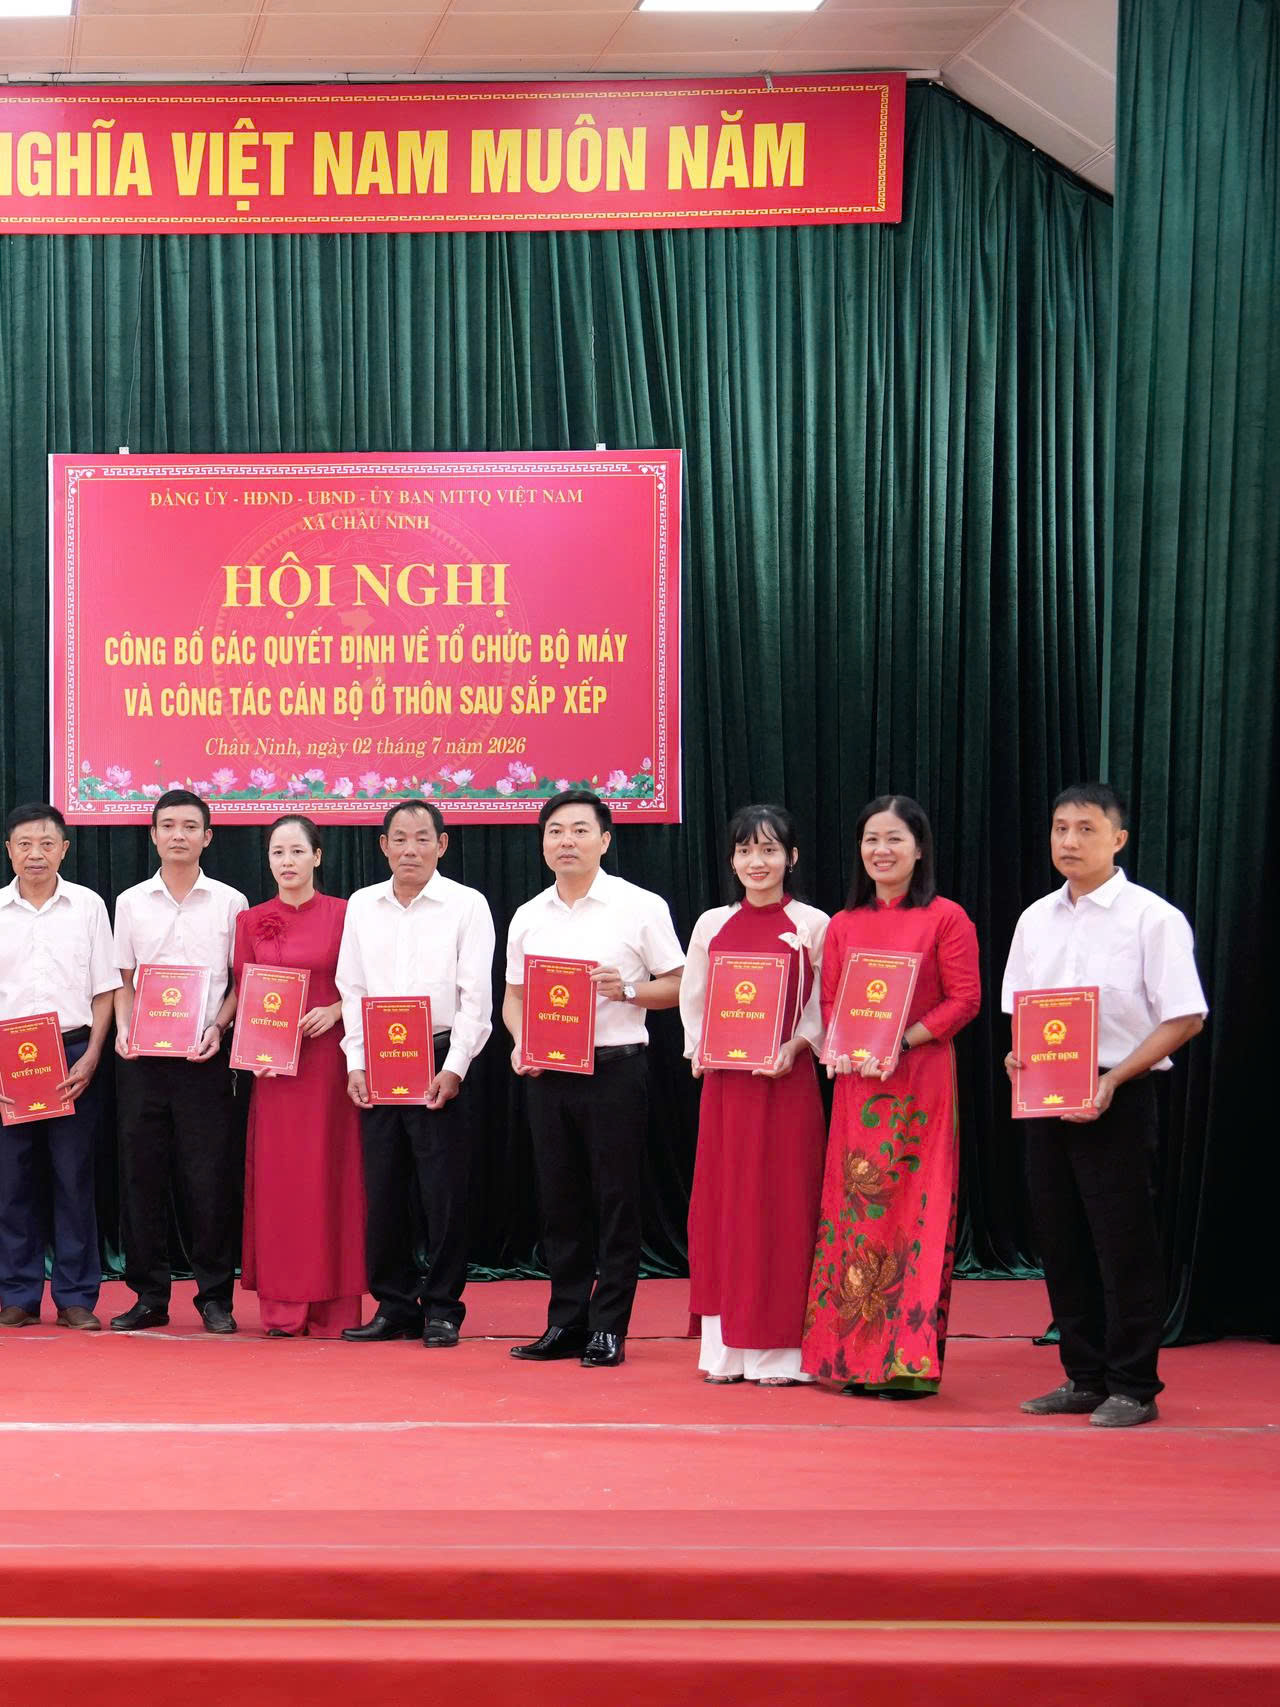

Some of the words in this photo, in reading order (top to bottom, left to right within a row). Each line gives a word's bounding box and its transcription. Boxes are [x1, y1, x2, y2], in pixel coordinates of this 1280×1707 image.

[172, 118, 293, 211] VIỆT
[314, 130, 448, 195] NAM
[471, 114, 646, 193] MUÔN
[668, 109, 805, 190] NĂM
[151, 488, 199, 506] ĐẢNG
[206, 488, 227, 505] ỦY
[309, 491, 355, 504] UBND
[371, 486, 393, 504] ỦY
[400, 491, 433, 503] BAN
[441, 490, 491, 506] MTTQ
[497, 486, 537, 506] VIỆT
[543, 490, 582, 502] NAM
[304, 514, 325, 530] XÃ
[332, 512, 381, 529] CHÂU
[387, 516, 428, 528] NINH
[222, 552, 335, 619] HỘI
[352, 564, 510, 617] NGHỊ
[105, 631, 166, 665] CÔNG
[174, 625, 203, 665] BỐ
[212, 630, 256, 664] CÁC
[264, 626, 333, 667] QUYẾT
[341, 634, 394, 669] ĐỊNH
[403, 625, 429, 663] VỀ
[436, 623, 464, 663] TỔ
[472, 628, 531, 663] CHỨC
[540, 629, 569, 668] BỘ
[578, 629, 627, 662] MÁY
[125, 682, 153, 716] VÀ
[161, 682, 222, 716] CÔNG
[230, 683, 271, 715] TÁC
[280, 681, 325, 715] CÁN
[334, 682, 363, 720] BỘ
[371, 676, 385, 714] Ở
[393, 680, 451, 714] THÔN
[460, 685, 502, 714] SAU
[511, 675, 555, 714] SẮP
[564, 676, 607, 713] XẾP
[206, 738, 249, 755] Châu
[254, 738, 301, 758] Ninh,
[306, 738, 348, 758] ngày
[353, 738, 372, 753] 02
[377, 737, 427, 758] tháng
[432, 737, 441, 753] 7
[446, 738, 482, 754] năm
[487, 737, 526, 753] 2026
